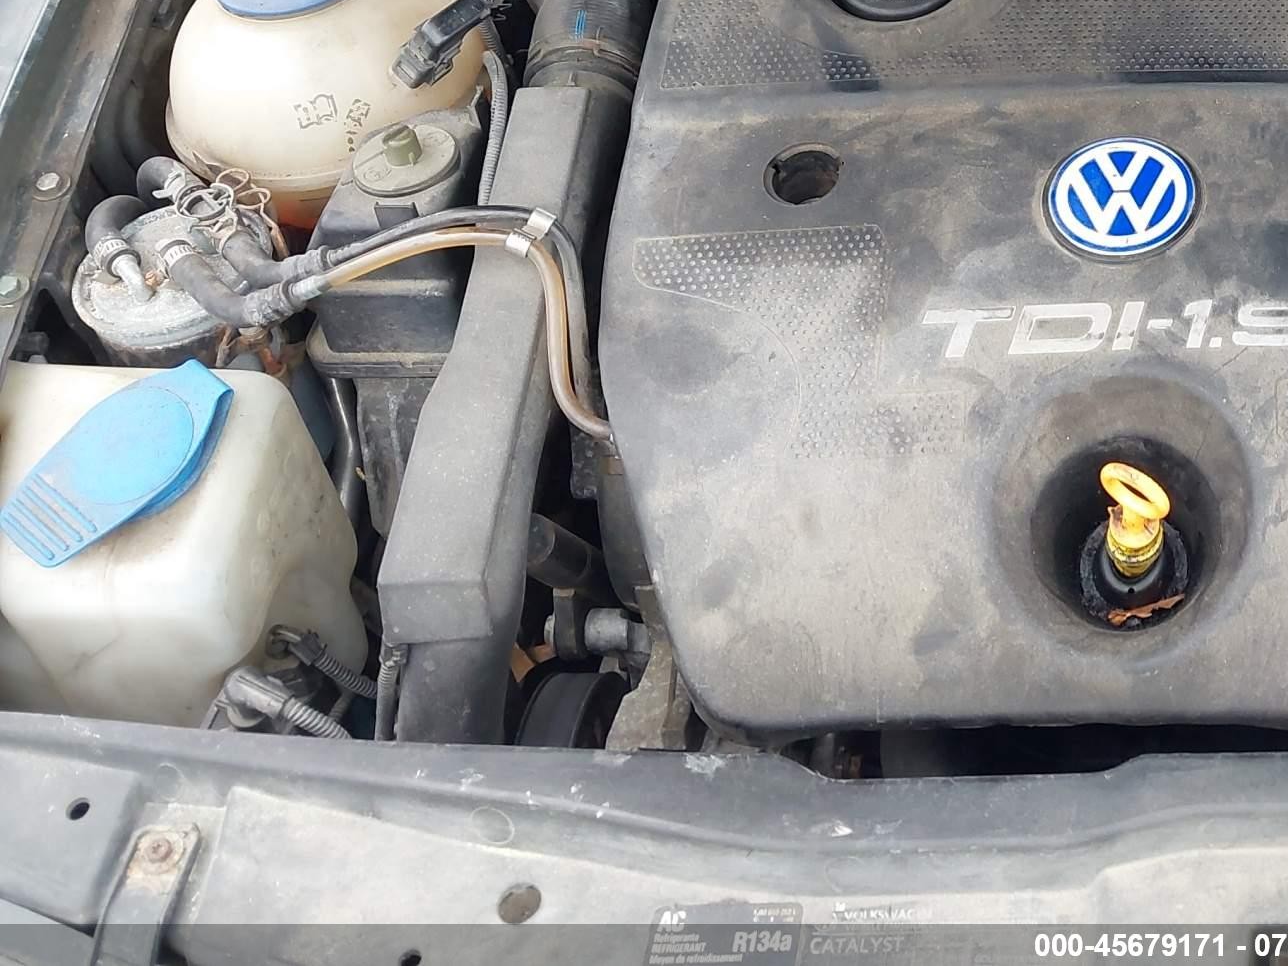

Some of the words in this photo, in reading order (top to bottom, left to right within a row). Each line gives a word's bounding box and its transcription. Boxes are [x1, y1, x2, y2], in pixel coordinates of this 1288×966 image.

[656, 910, 687, 932] AC
[654, 932, 700, 944] Refrigerante
[732, 930, 793, 953] R134a
[650, 942, 707, 954] REFRIGERANT
[809, 937, 905, 955] CATALYST
[649, 954, 675, 965] Moyen
[675, 954, 686, 964] de
